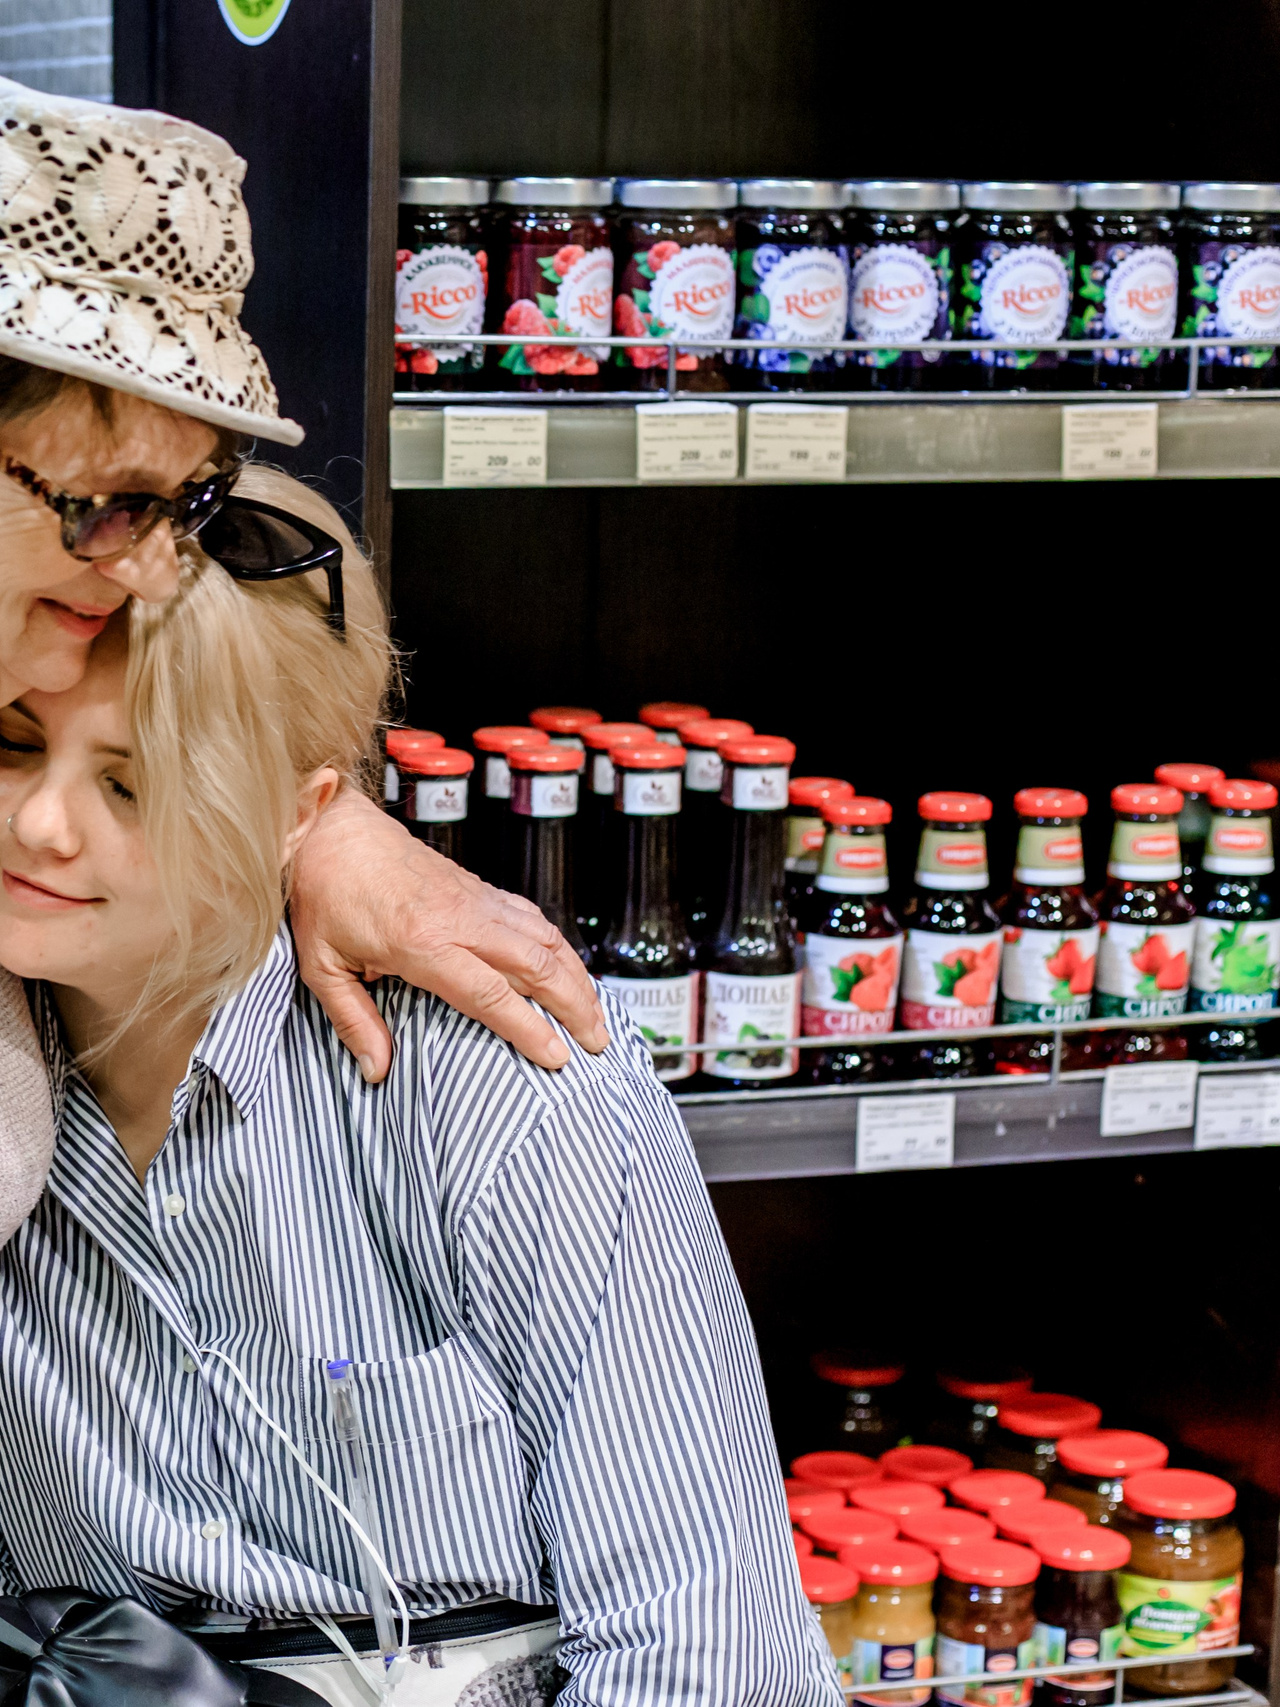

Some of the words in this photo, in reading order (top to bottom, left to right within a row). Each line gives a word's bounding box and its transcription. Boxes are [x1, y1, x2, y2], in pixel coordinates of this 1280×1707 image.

[410, 284, 477, 319] Ricco
[862, 283, 925, 314] Ricco
[1003, 284, 1061, 315] Ricco
